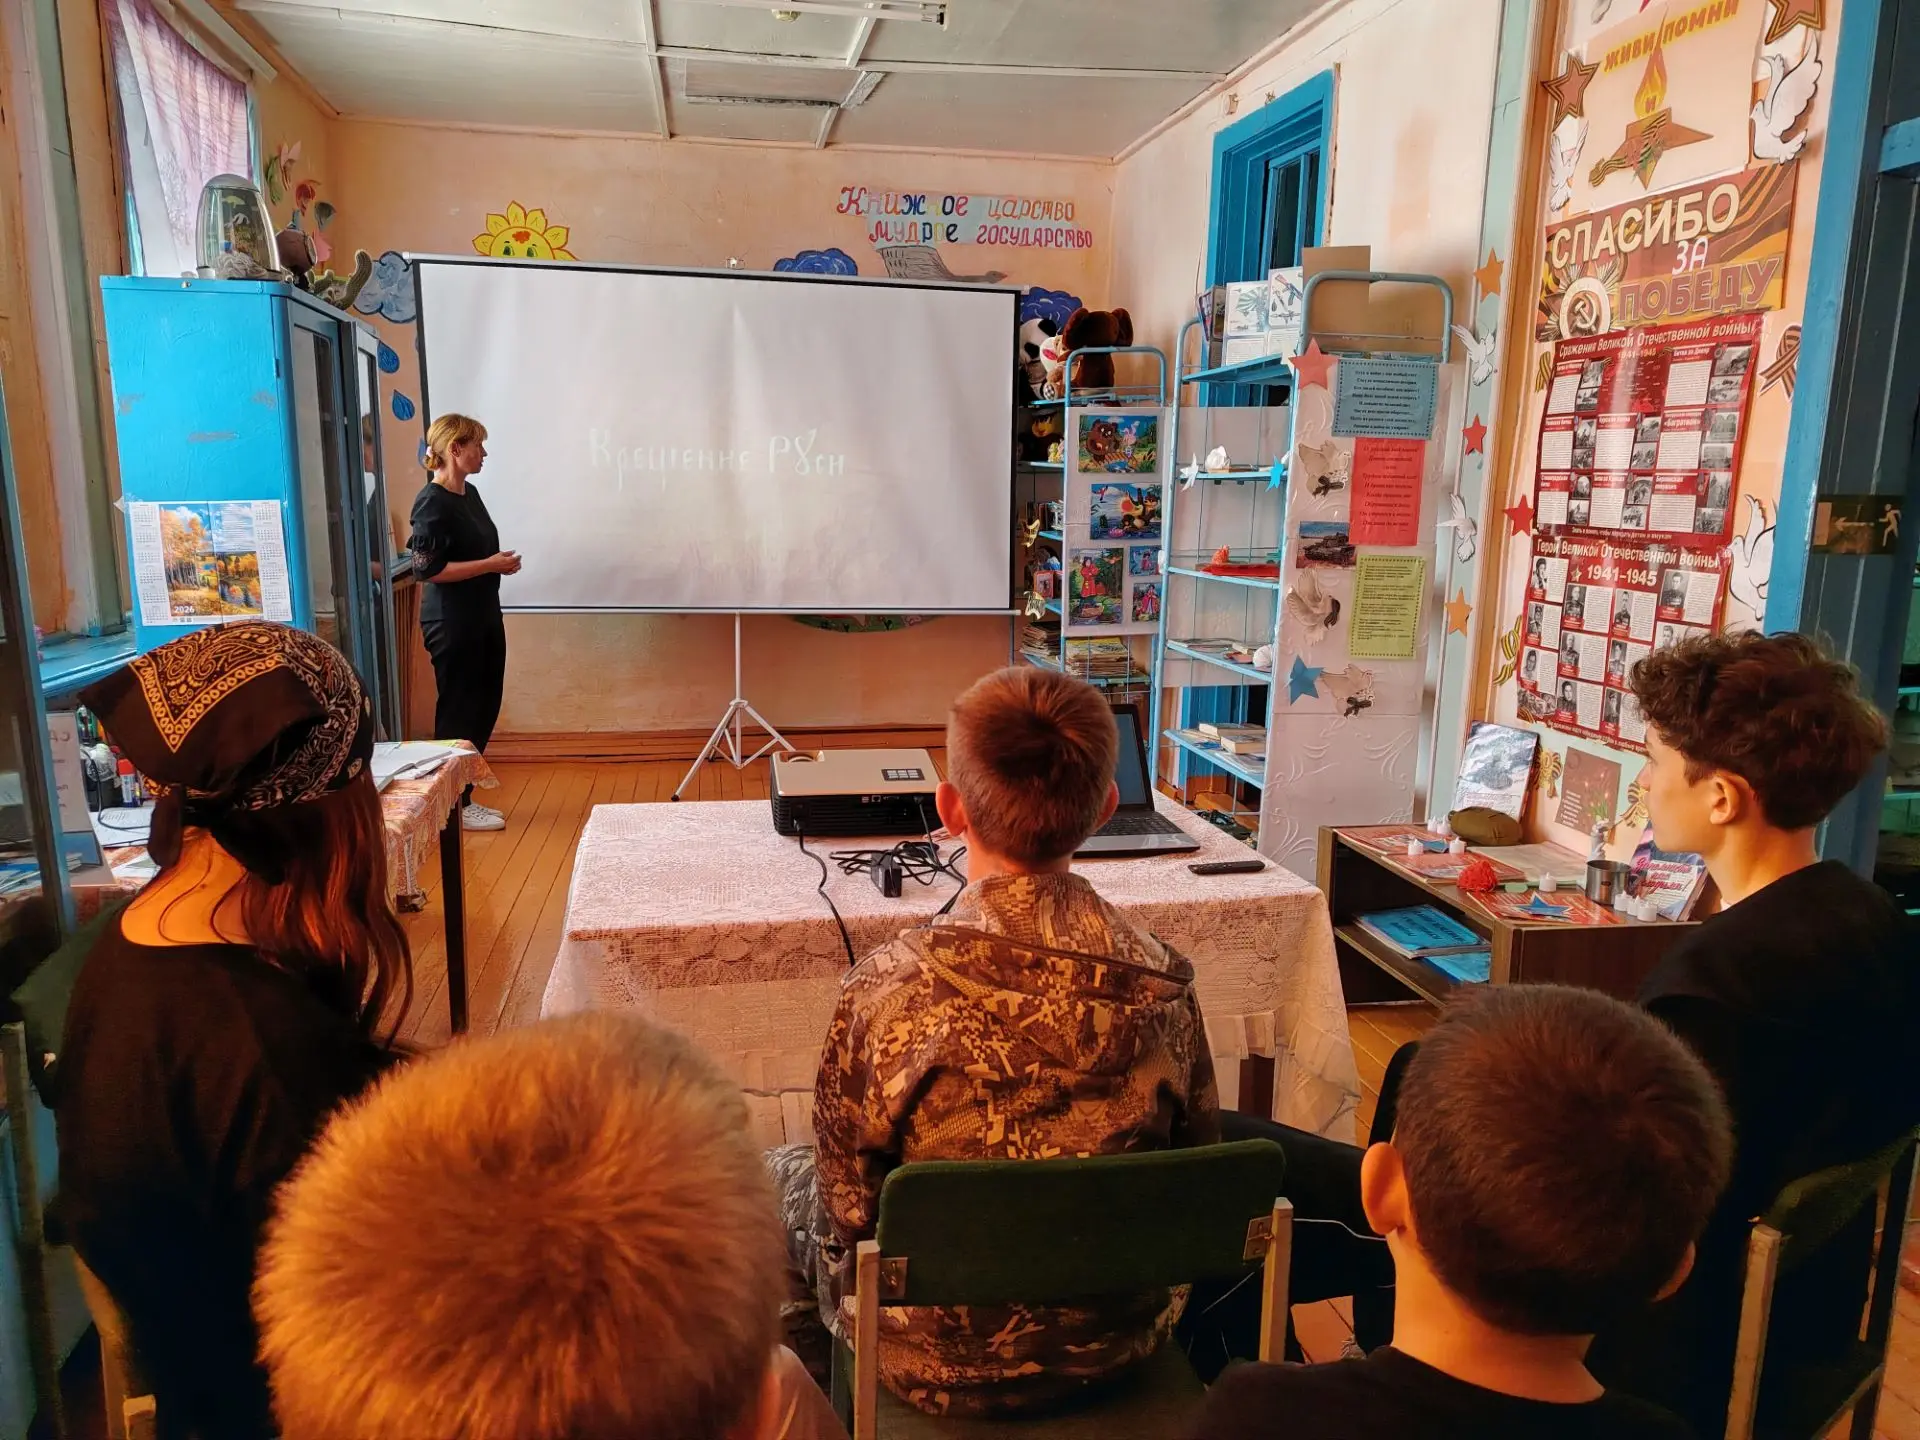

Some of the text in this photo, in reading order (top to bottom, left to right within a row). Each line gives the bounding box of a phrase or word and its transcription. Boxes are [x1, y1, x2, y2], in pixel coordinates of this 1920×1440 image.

[1604, 0, 1739, 72] ЖИВИ ПОМНИ
[836, 186, 1075, 221] Книжное царство
[976, 224, 1093, 248] государство
[1551, 183, 1741, 270] СПАСИБО
[1671, 235, 1710, 275] ЗА
[1618, 256, 1783, 323] ПОБЕДУ
[1560, 319, 1751, 358] Сражения Великой Отечественной войны
[1561, 541, 1599, 558] Великой
[1601, 542, 1676, 564] Отечественной
[1679, 550, 1719, 568] войны
[1587, 564, 1657, 586] 1941-1945
[174, 605, 195, 614] 2026
